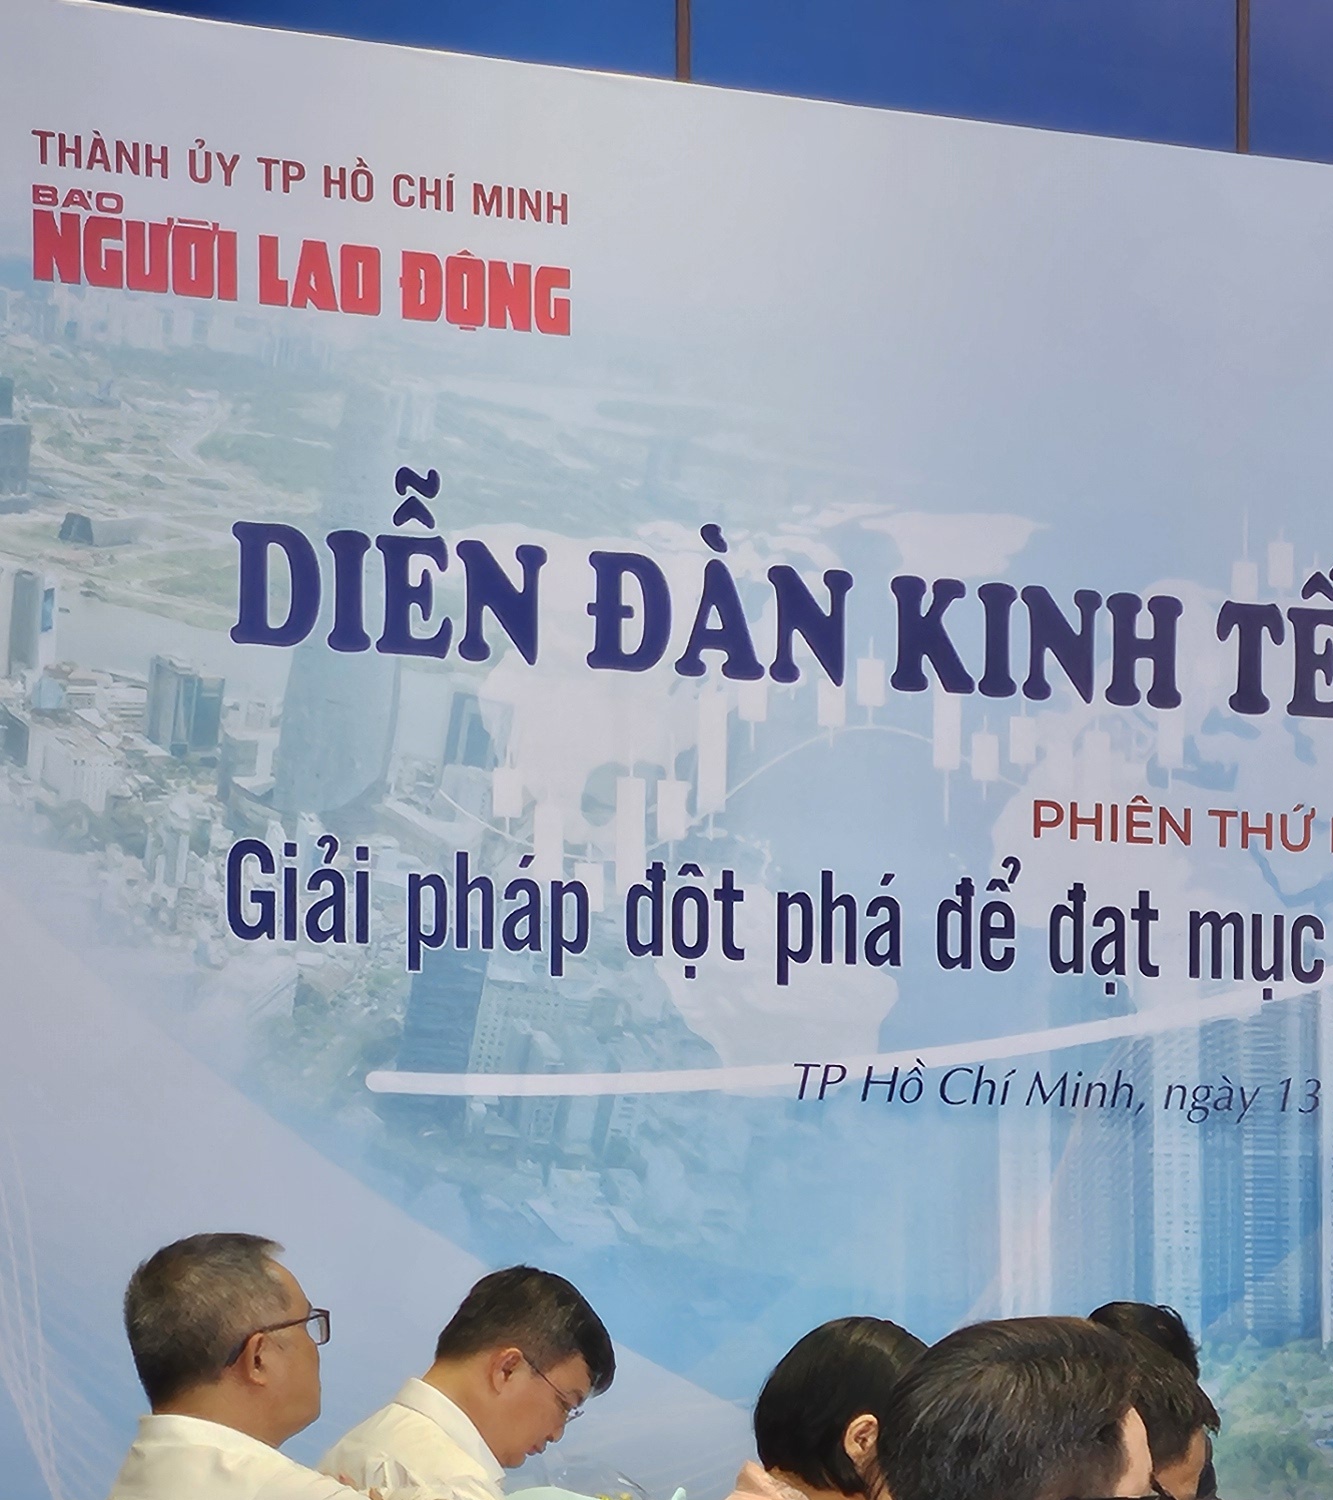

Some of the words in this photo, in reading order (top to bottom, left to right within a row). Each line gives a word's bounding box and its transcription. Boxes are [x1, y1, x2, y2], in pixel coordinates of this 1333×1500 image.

[31, 130, 168, 179] THÀNH
[188, 139, 240, 187] ỦY
[257, 157, 306, 193] TP
[323, 157, 373, 202] HỒ
[392, 172, 454, 214] CHÍ
[473, 183, 569, 225] MINH
[32, 184, 124, 214] BÁO
[33, 209, 237, 301] NGƯỜI
[259, 234, 381, 316] LAO
[400, 248, 571, 335] ĐỘNG
[231, 467, 548, 666] DIỄN
[587, 524, 853, 686] ĐÀN
[891, 575, 1183, 709] KINH
[1032, 795, 1192, 847] PHIÊN
[1207, 803, 1315, 853] THỨ
[226, 835, 370, 944] Giải
[407, 851, 590, 977] pháp
[626, 862, 746, 980] đột
[777, 870, 901, 985] phá
[936, 857, 1021, 973] để
[1049, 883, 1160, 996] đạt
[1188, 908, 1325, 1001] mục
[792, 1062, 846, 1101] TP
[862, 1058, 926, 1104] Hồ
[939, 1065, 1014, 1106] Chí
[1025, 1072, 1145, 1115] Minh,
[1163, 1078, 1263, 1123] ngày
[1277, 1077, 1321, 1115] 13
